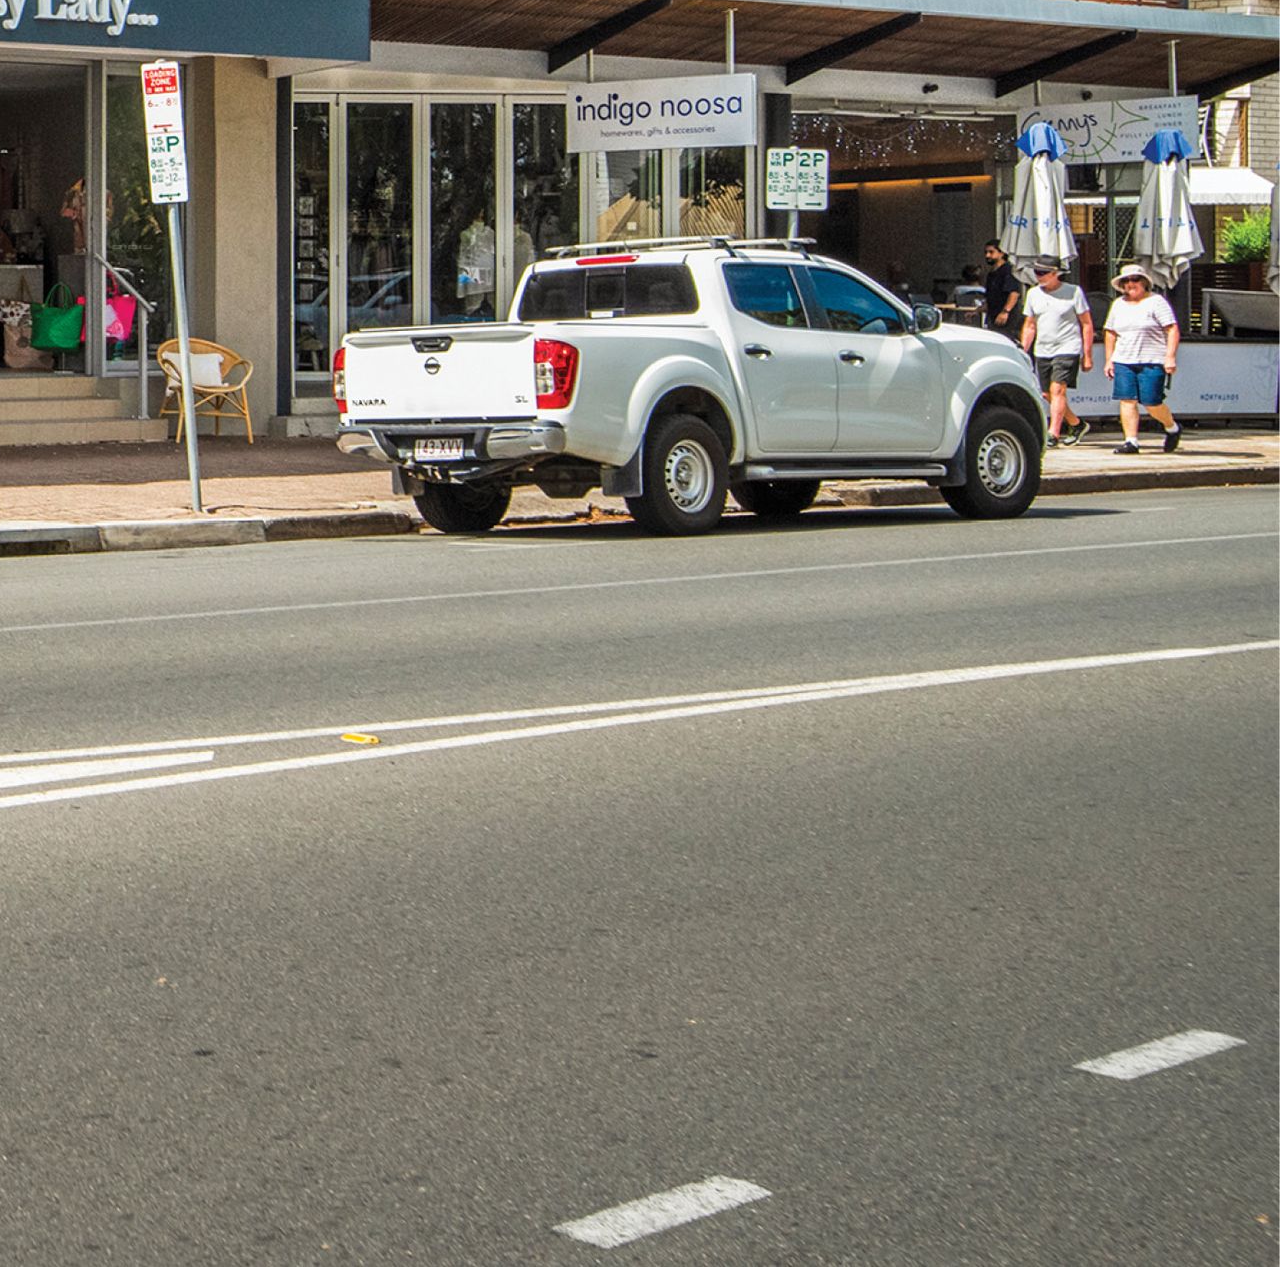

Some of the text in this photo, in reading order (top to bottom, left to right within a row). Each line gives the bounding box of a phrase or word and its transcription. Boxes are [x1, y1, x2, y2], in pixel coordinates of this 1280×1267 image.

[144, 69, 176, 80] LOADING
[150, 77, 172, 87] ZONE
[575, 93, 742, 126] indigo noosa
[1138, 102, 1182, 111] BREAKFAST
[664, 127, 671, 135] &
[672, 124, 716, 135] accessories
[151, 136, 163, 146] 15
[166, 135, 180, 153] P
[352, 398, 387, 407] NAVARA
[514, 394, 529, 404] SL
